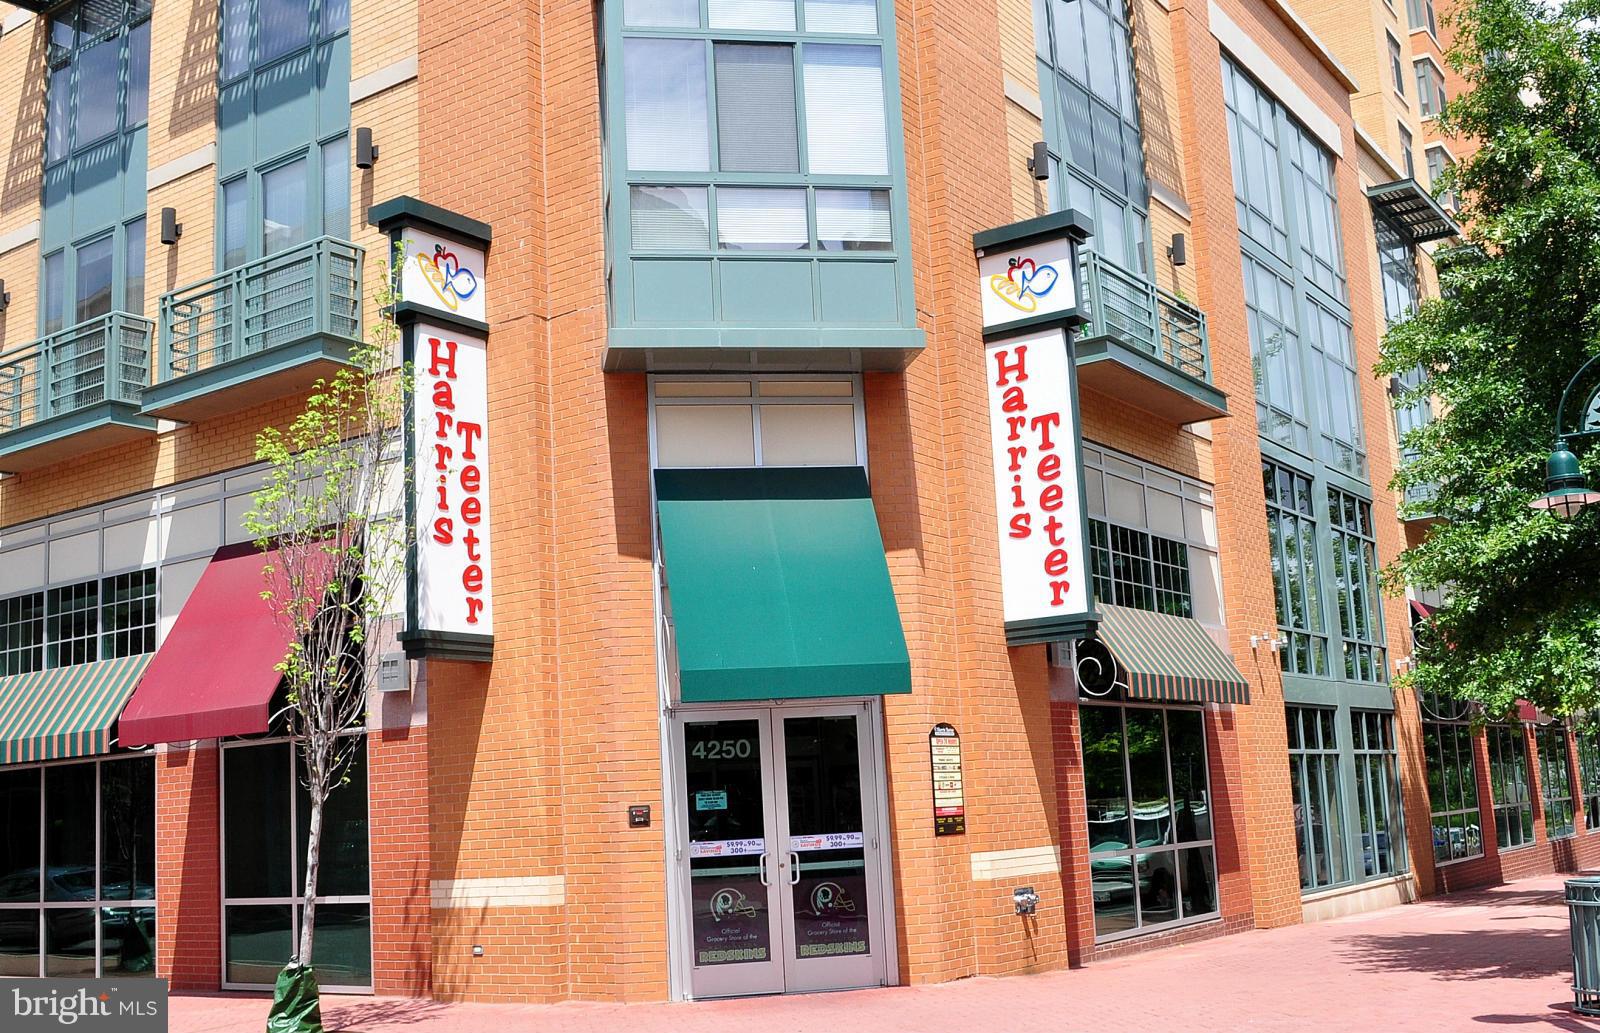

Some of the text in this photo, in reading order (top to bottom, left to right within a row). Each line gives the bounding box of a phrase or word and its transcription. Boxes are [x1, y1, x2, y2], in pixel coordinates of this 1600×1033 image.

[427, 337, 457, 545] Harris
[456, 421, 484, 625] Teeter
[994, 345, 1032, 540] Harris
[1031, 412, 1070, 607] Teeter
[691, 738, 751, 759] 4250
[699, 947, 767, 963] REDSKINS
[800, 941, 866, 956] REDSKINS
